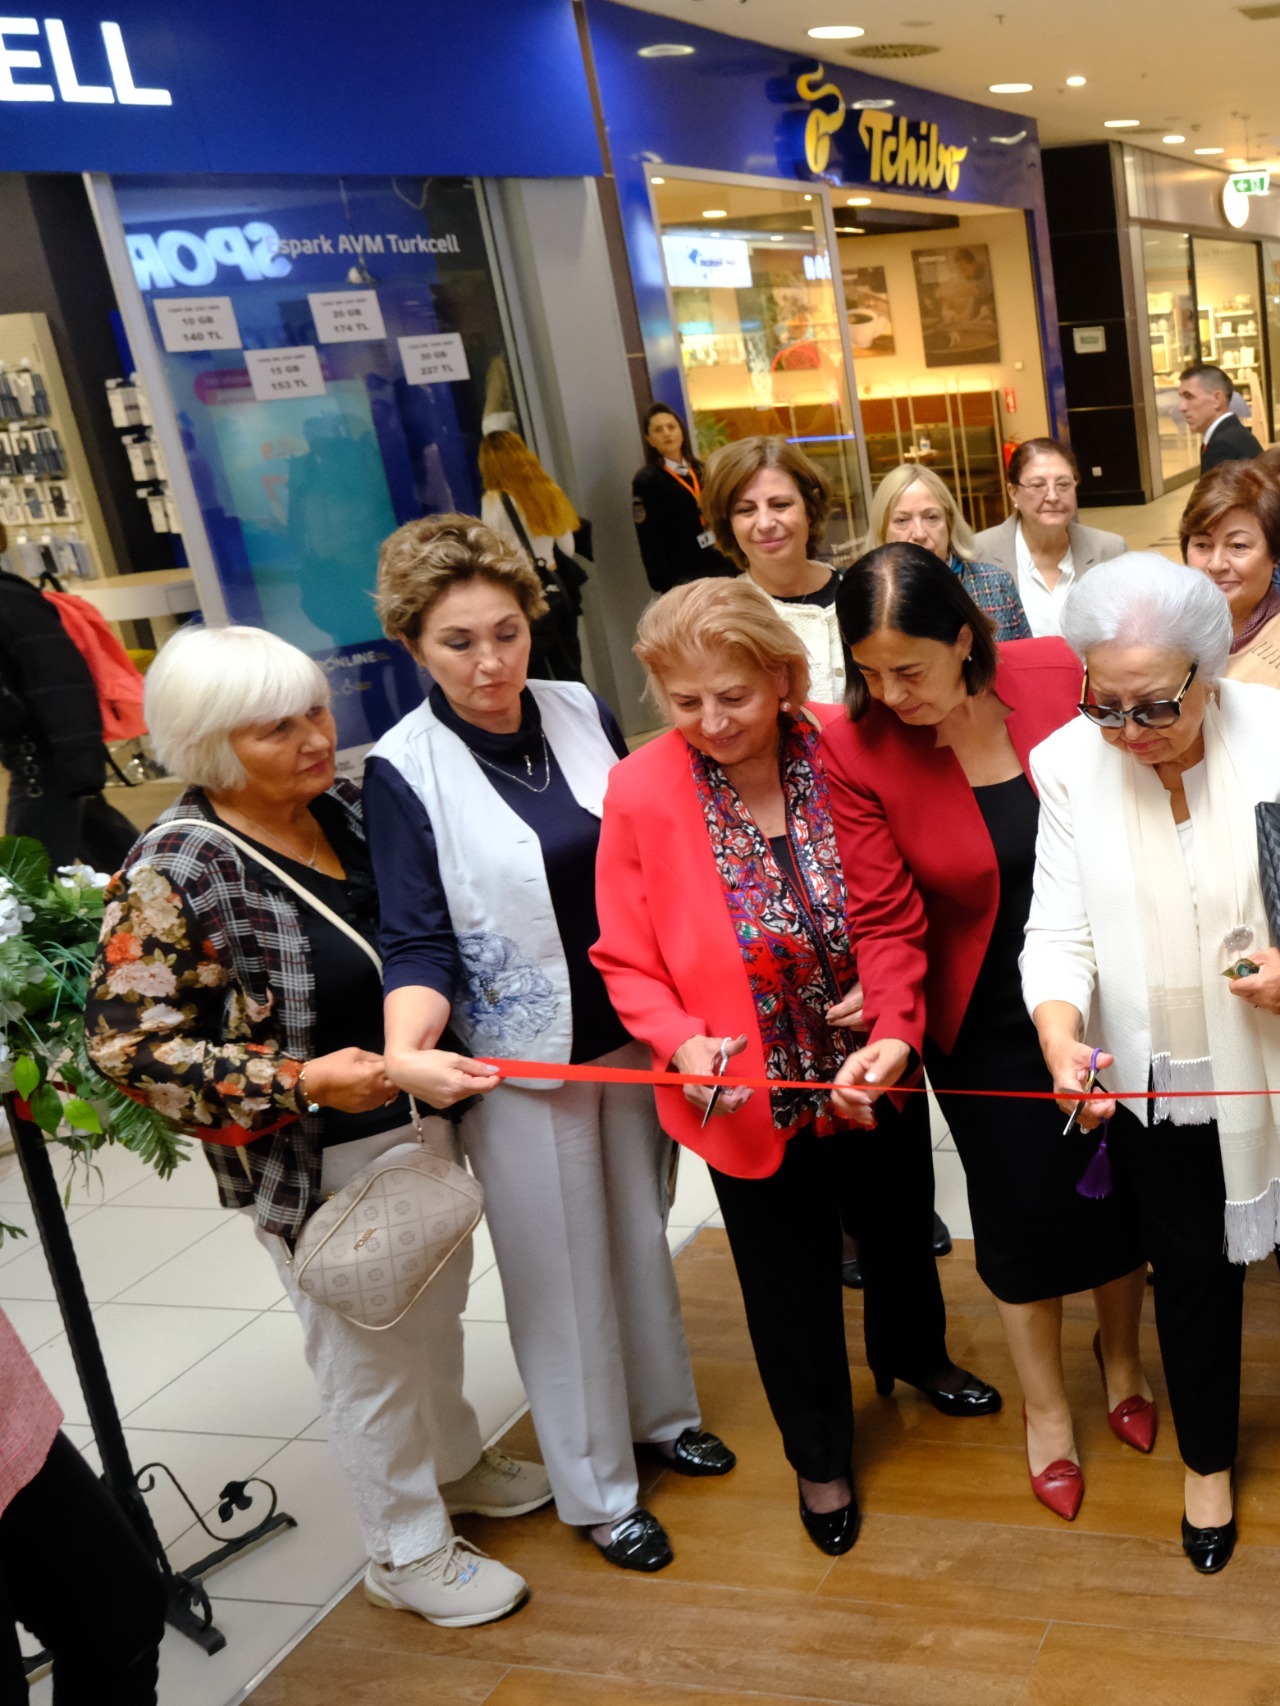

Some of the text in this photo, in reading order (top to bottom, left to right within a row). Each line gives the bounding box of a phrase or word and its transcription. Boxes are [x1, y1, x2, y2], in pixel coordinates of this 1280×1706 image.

[0, 16, 173, 106] ELL
[858, 109, 968, 192] Tchibo
[338, 234, 385, 254] AVM
[386, 233, 461, 254] Turkcell
[347, 308, 362, 317] GB
[198, 315, 214, 325] GB
[355, 323, 370, 331] TL
[207, 331, 223, 340] TL
[285, 365, 300, 374] GB
[294, 380, 309, 388] TL
